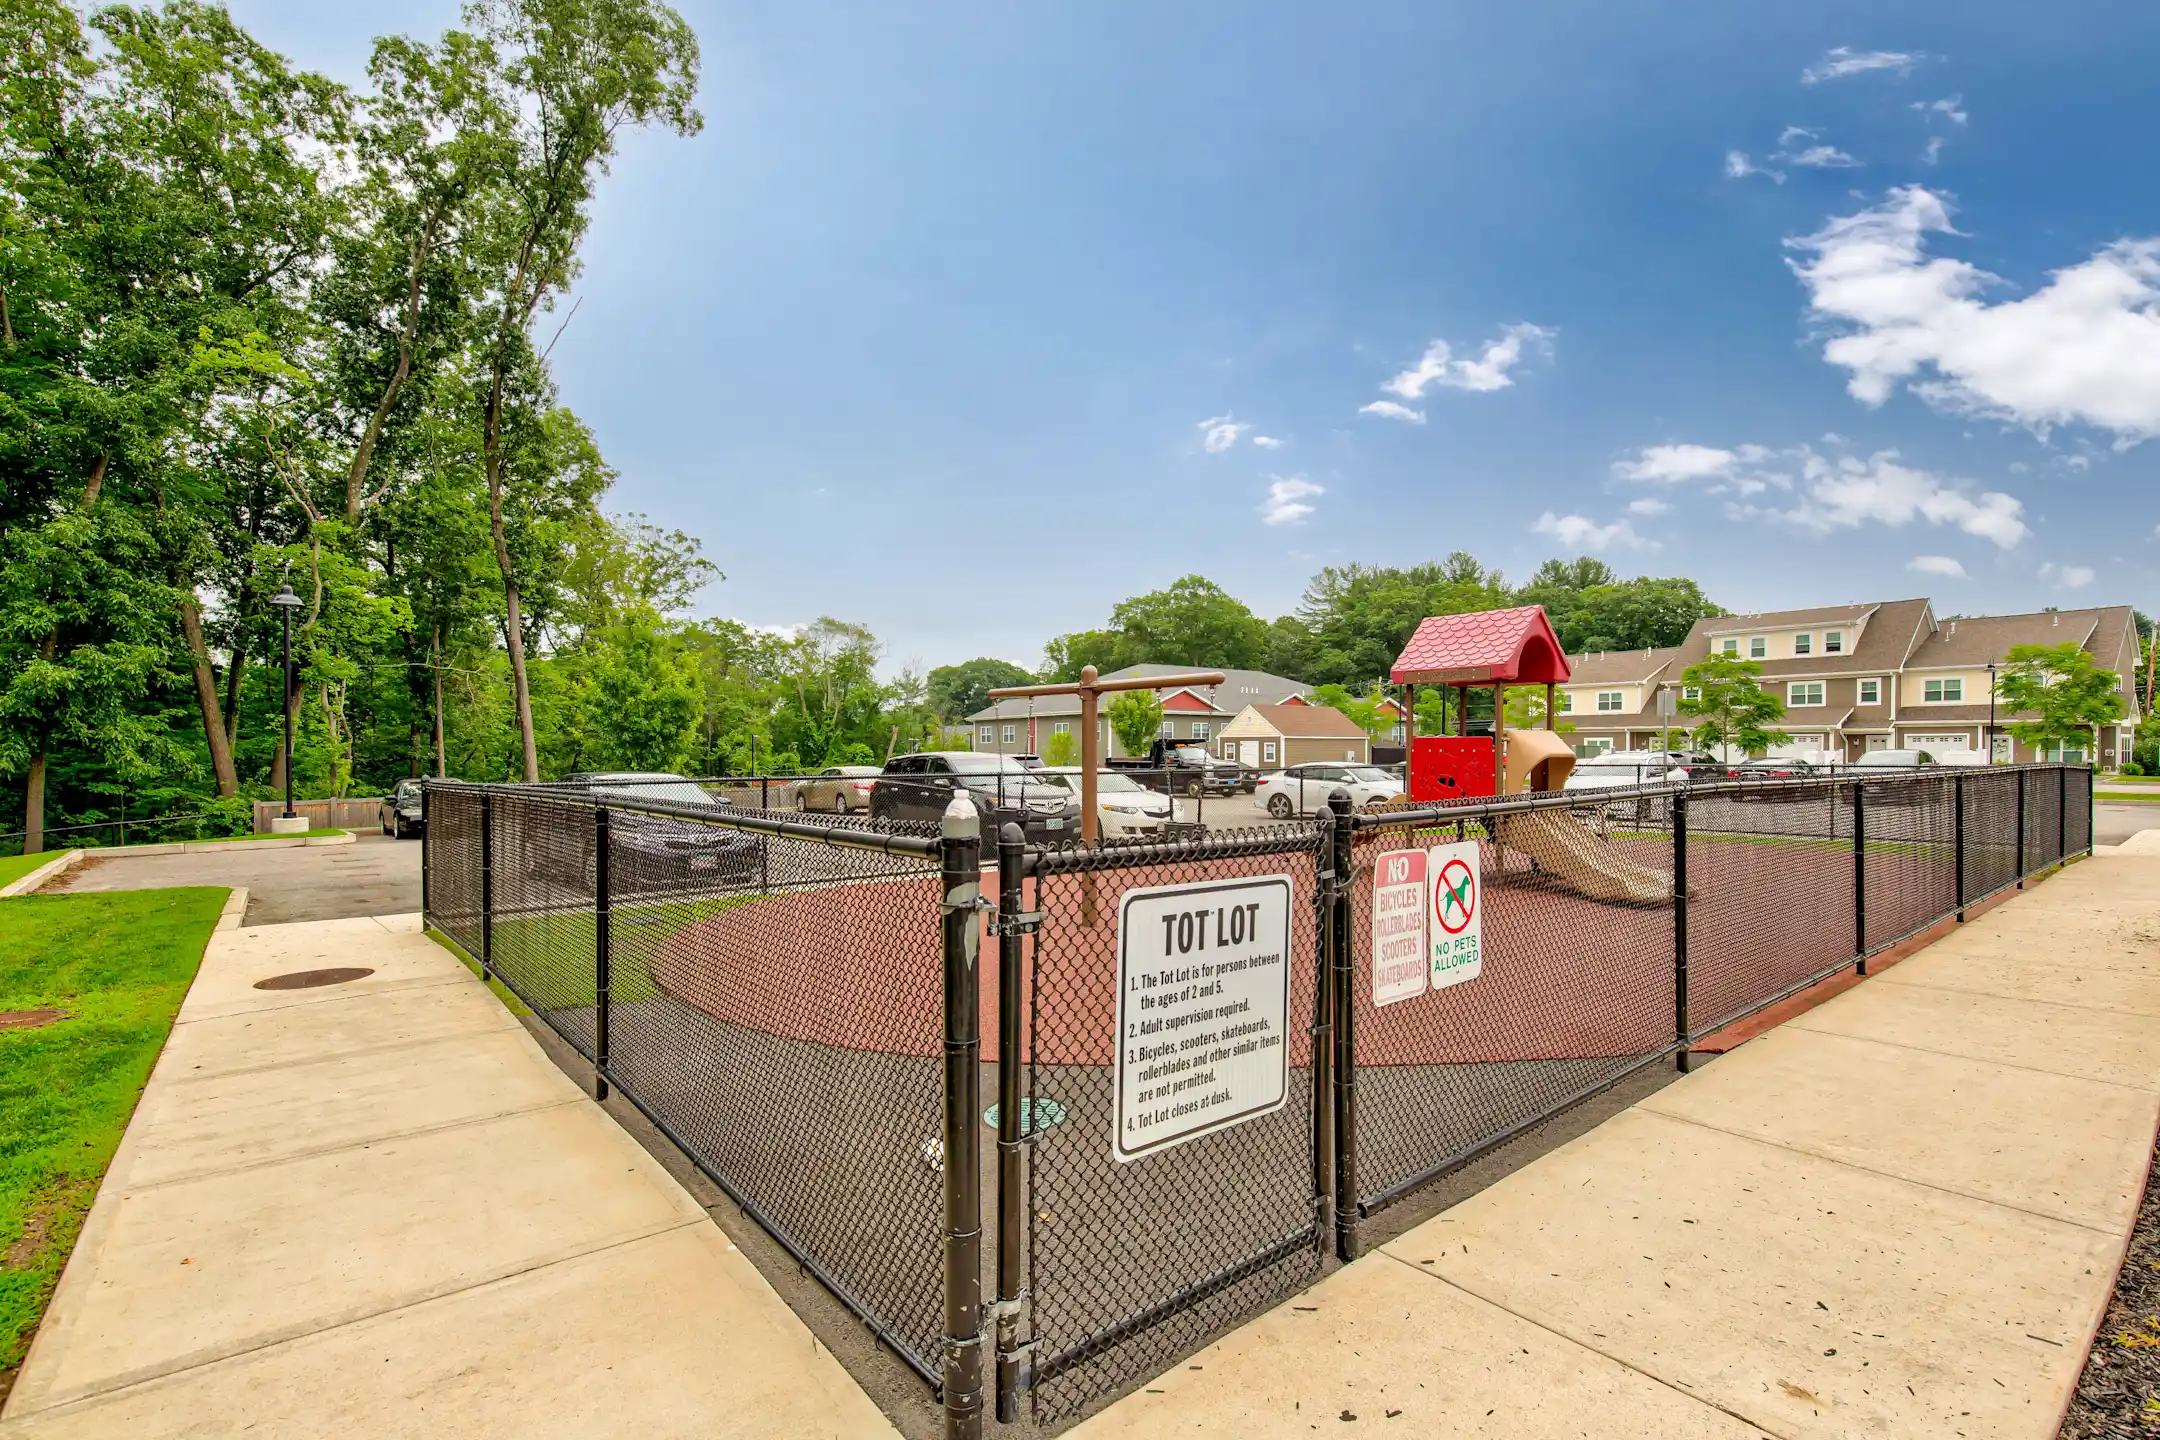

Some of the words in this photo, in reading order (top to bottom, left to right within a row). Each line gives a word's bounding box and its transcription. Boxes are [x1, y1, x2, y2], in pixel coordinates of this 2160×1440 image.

[1388, 856, 1409, 884] NO
[1380, 888, 1417, 913] BICYCLES
[1162, 910, 1209, 956] TOT
[1217, 903, 1260, 948] LOT
[1377, 911, 1422, 938] ROLLERBLADES
[1382, 936, 1417, 962] SCOOTERS
[1436, 941, 1450, 956] NO
[1454, 935, 1476, 952] PETS
[1130, 976, 1138, 991] 1.
[1142, 974, 1157, 988] The
[1160, 970, 1174, 985] Tot
[1176, 968, 1190, 982] Lot
[1192, 966, 1200, 979] is
[1202, 963, 1214, 978] for
[1216, 958, 1247, 978] persons
[1250, 953, 1280, 968] between
[1378, 960, 1422, 988] SKATEBOARDS
[1434, 950, 1479, 972] ALLOWED
[1141, 994, 1154, 1010] the
[1158, 992, 1178, 1008] ages
[1180, 987, 1190, 1001] of
[1192, 985, 1197, 998] 2
[1200, 982, 1214, 997] and
[1216, 980, 1224, 994] 5.
[1129, 1024, 1138, 1038] 2.
[1140, 1019, 1163, 1036] Adult
[1166, 1010, 1213, 1031] supervision
[1216, 998, 1250, 1019] required.
[1128, 1050, 1137, 1064] 3.
[1140, 1041, 1178, 1062] Bicycles,
[1180, 1032, 1219, 1050] scooters,
[1222, 1017, 1270, 1041] skateboards,
[1138, 1057, 1190, 1083] rollerblades
[1193, 1051, 1208, 1067] and
[1210, 1046, 1231, 1064] other
[1232, 1039, 1258, 1056] similar
[1260, 1034, 1280, 1048] items
[1138, 1090, 1153, 1103] are
[1156, 1082, 1170, 1098] not
[1173, 1068, 1216, 1096] permitted.
[1127, 1118, 1136, 1132] 4.
[1138, 1112, 1152, 1130] Tot
[1155, 1107, 1169, 1124] Lot
[1172, 1100, 1198, 1118] closes
[1200, 1096, 1210, 1108] at
[1212, 1087, 1232, 1104] dusk.
